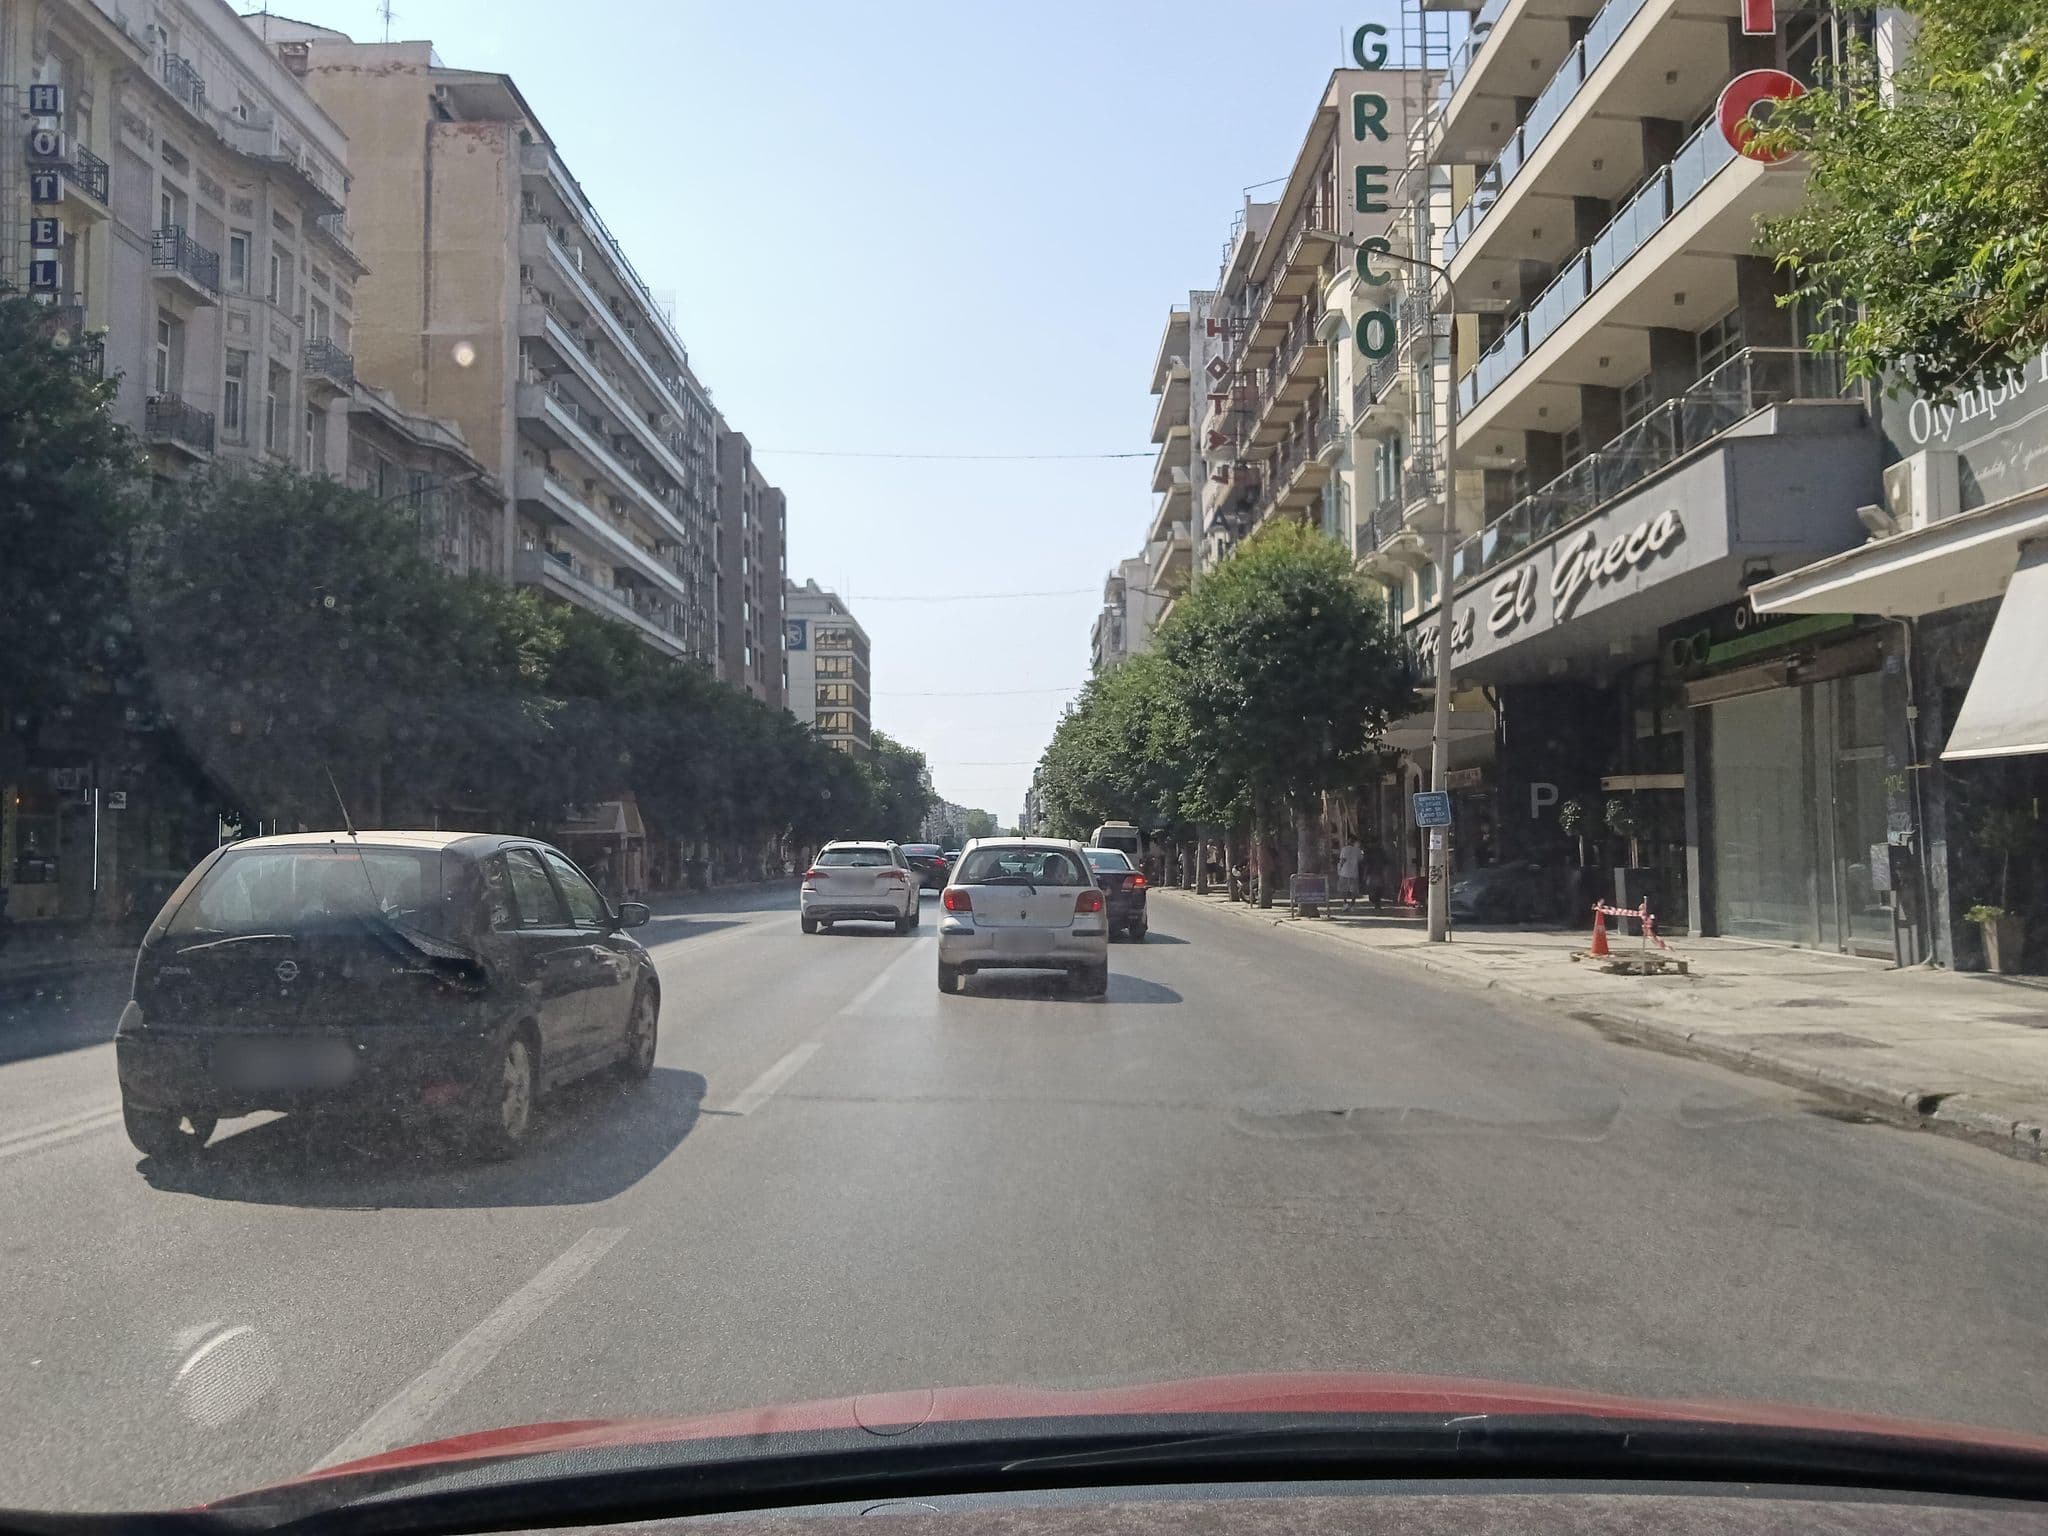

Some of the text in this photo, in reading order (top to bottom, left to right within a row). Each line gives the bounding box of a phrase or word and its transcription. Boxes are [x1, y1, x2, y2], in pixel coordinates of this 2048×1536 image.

[32, 86, 57, 288] HOTEL
[1353, 23, 1396, 359] GRECO
[1487, 564, 1537, 632] El
[1550, 509, 1682, 619] Greco
[1530, 782, 1559, 819] P
